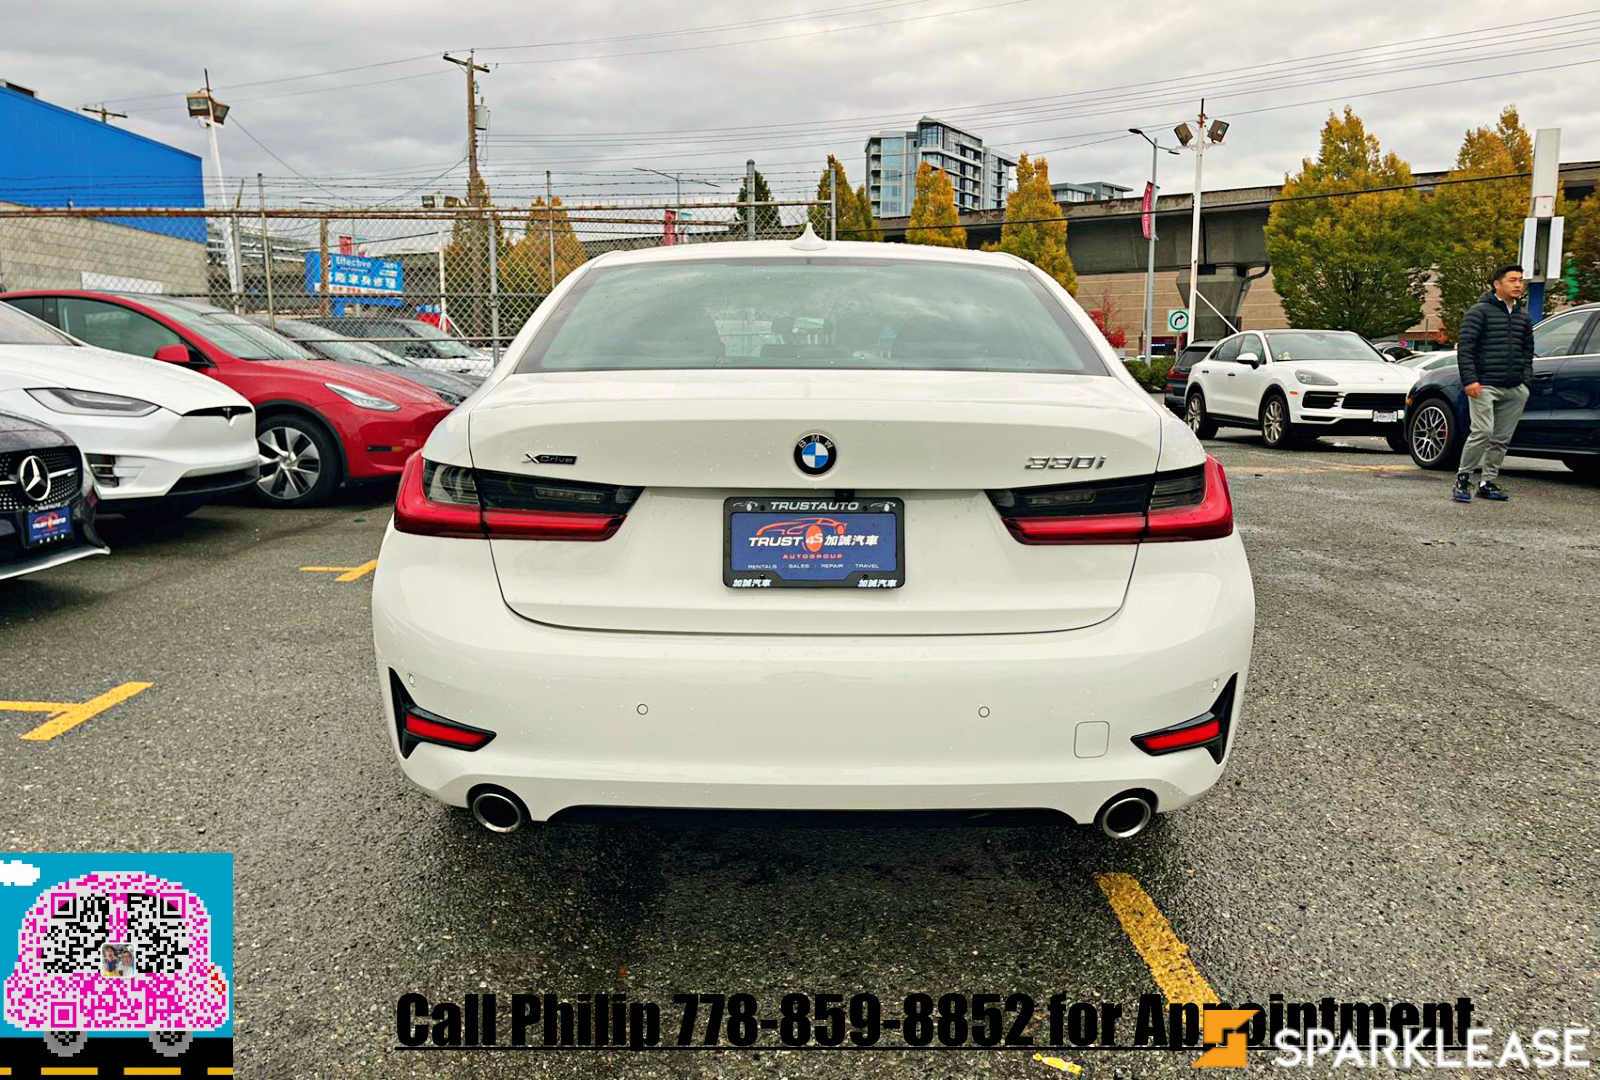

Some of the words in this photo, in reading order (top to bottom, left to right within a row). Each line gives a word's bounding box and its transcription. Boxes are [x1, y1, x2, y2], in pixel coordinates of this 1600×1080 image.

[1024, 455, 1107, 470] 330i
[770, 501, 860, 510] TRUSTAUTO
[748, 536, 804, 547] TRUST
